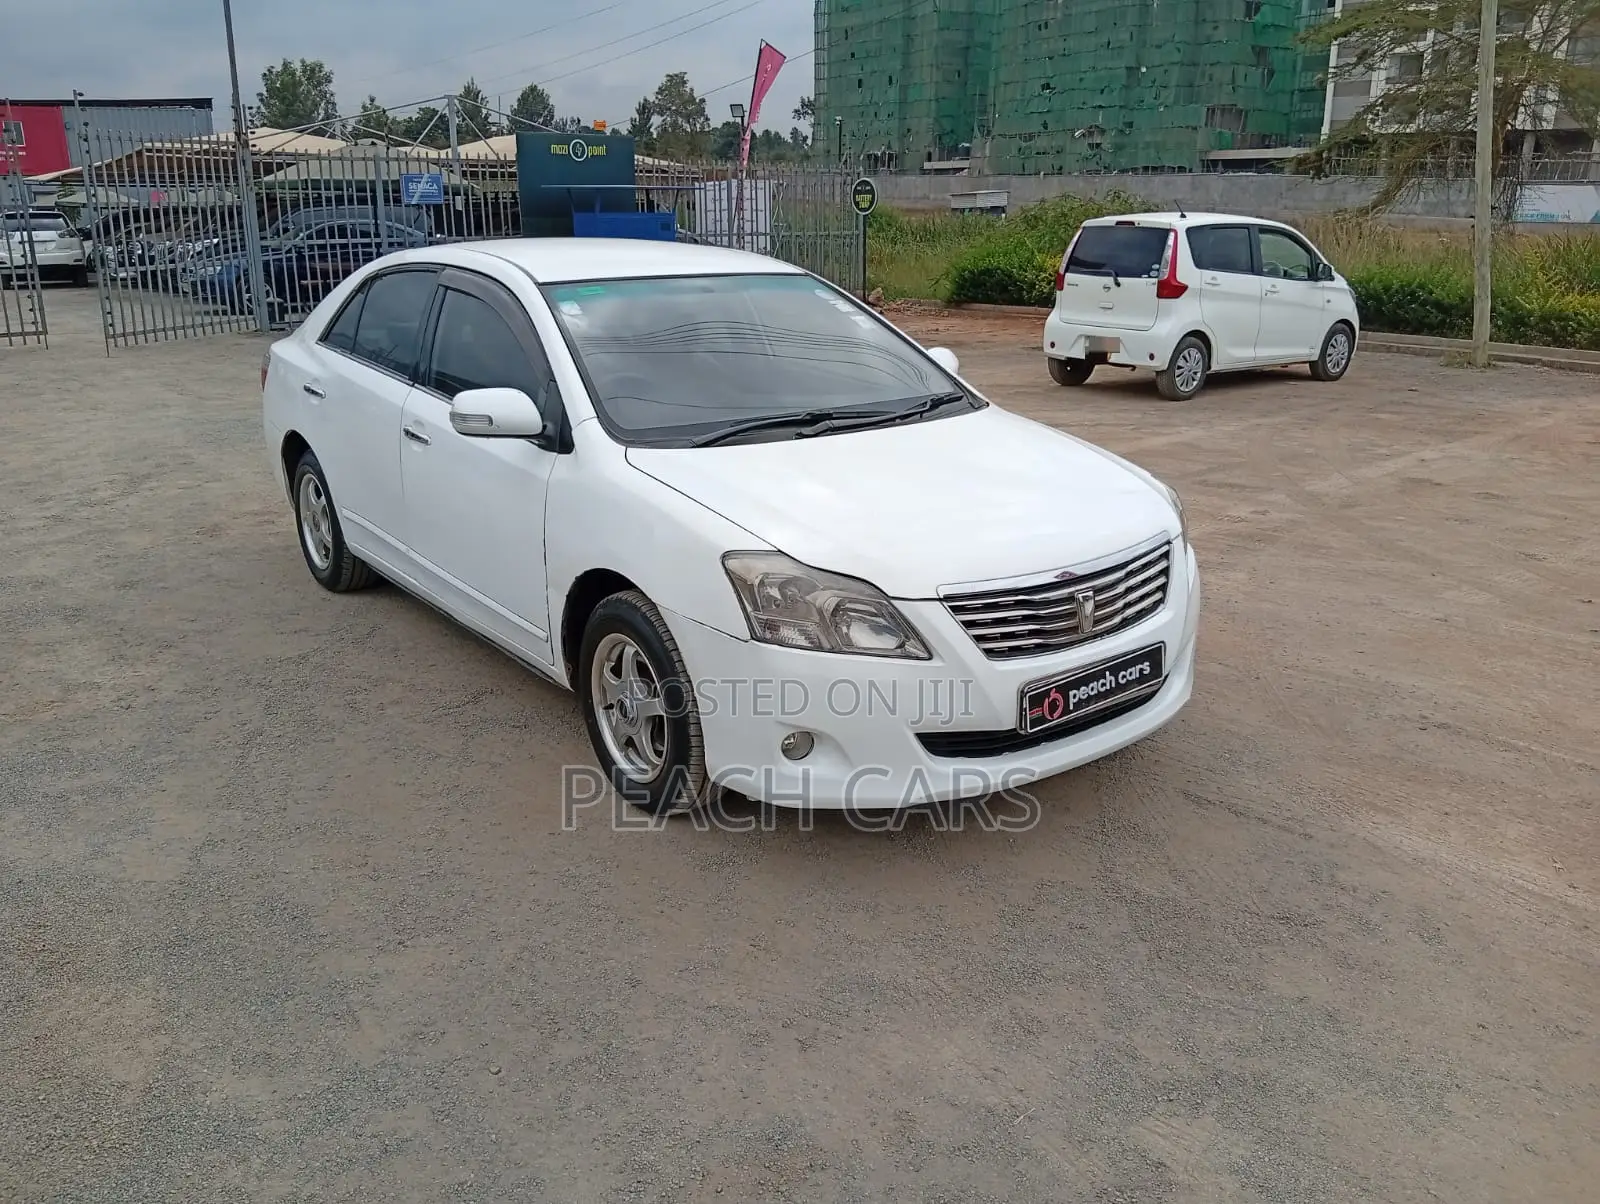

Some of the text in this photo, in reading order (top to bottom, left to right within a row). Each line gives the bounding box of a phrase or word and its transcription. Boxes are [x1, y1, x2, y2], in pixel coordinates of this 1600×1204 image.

[588, 144, 606, 158] point
[1068, 661, 1151, 710] peach cars
